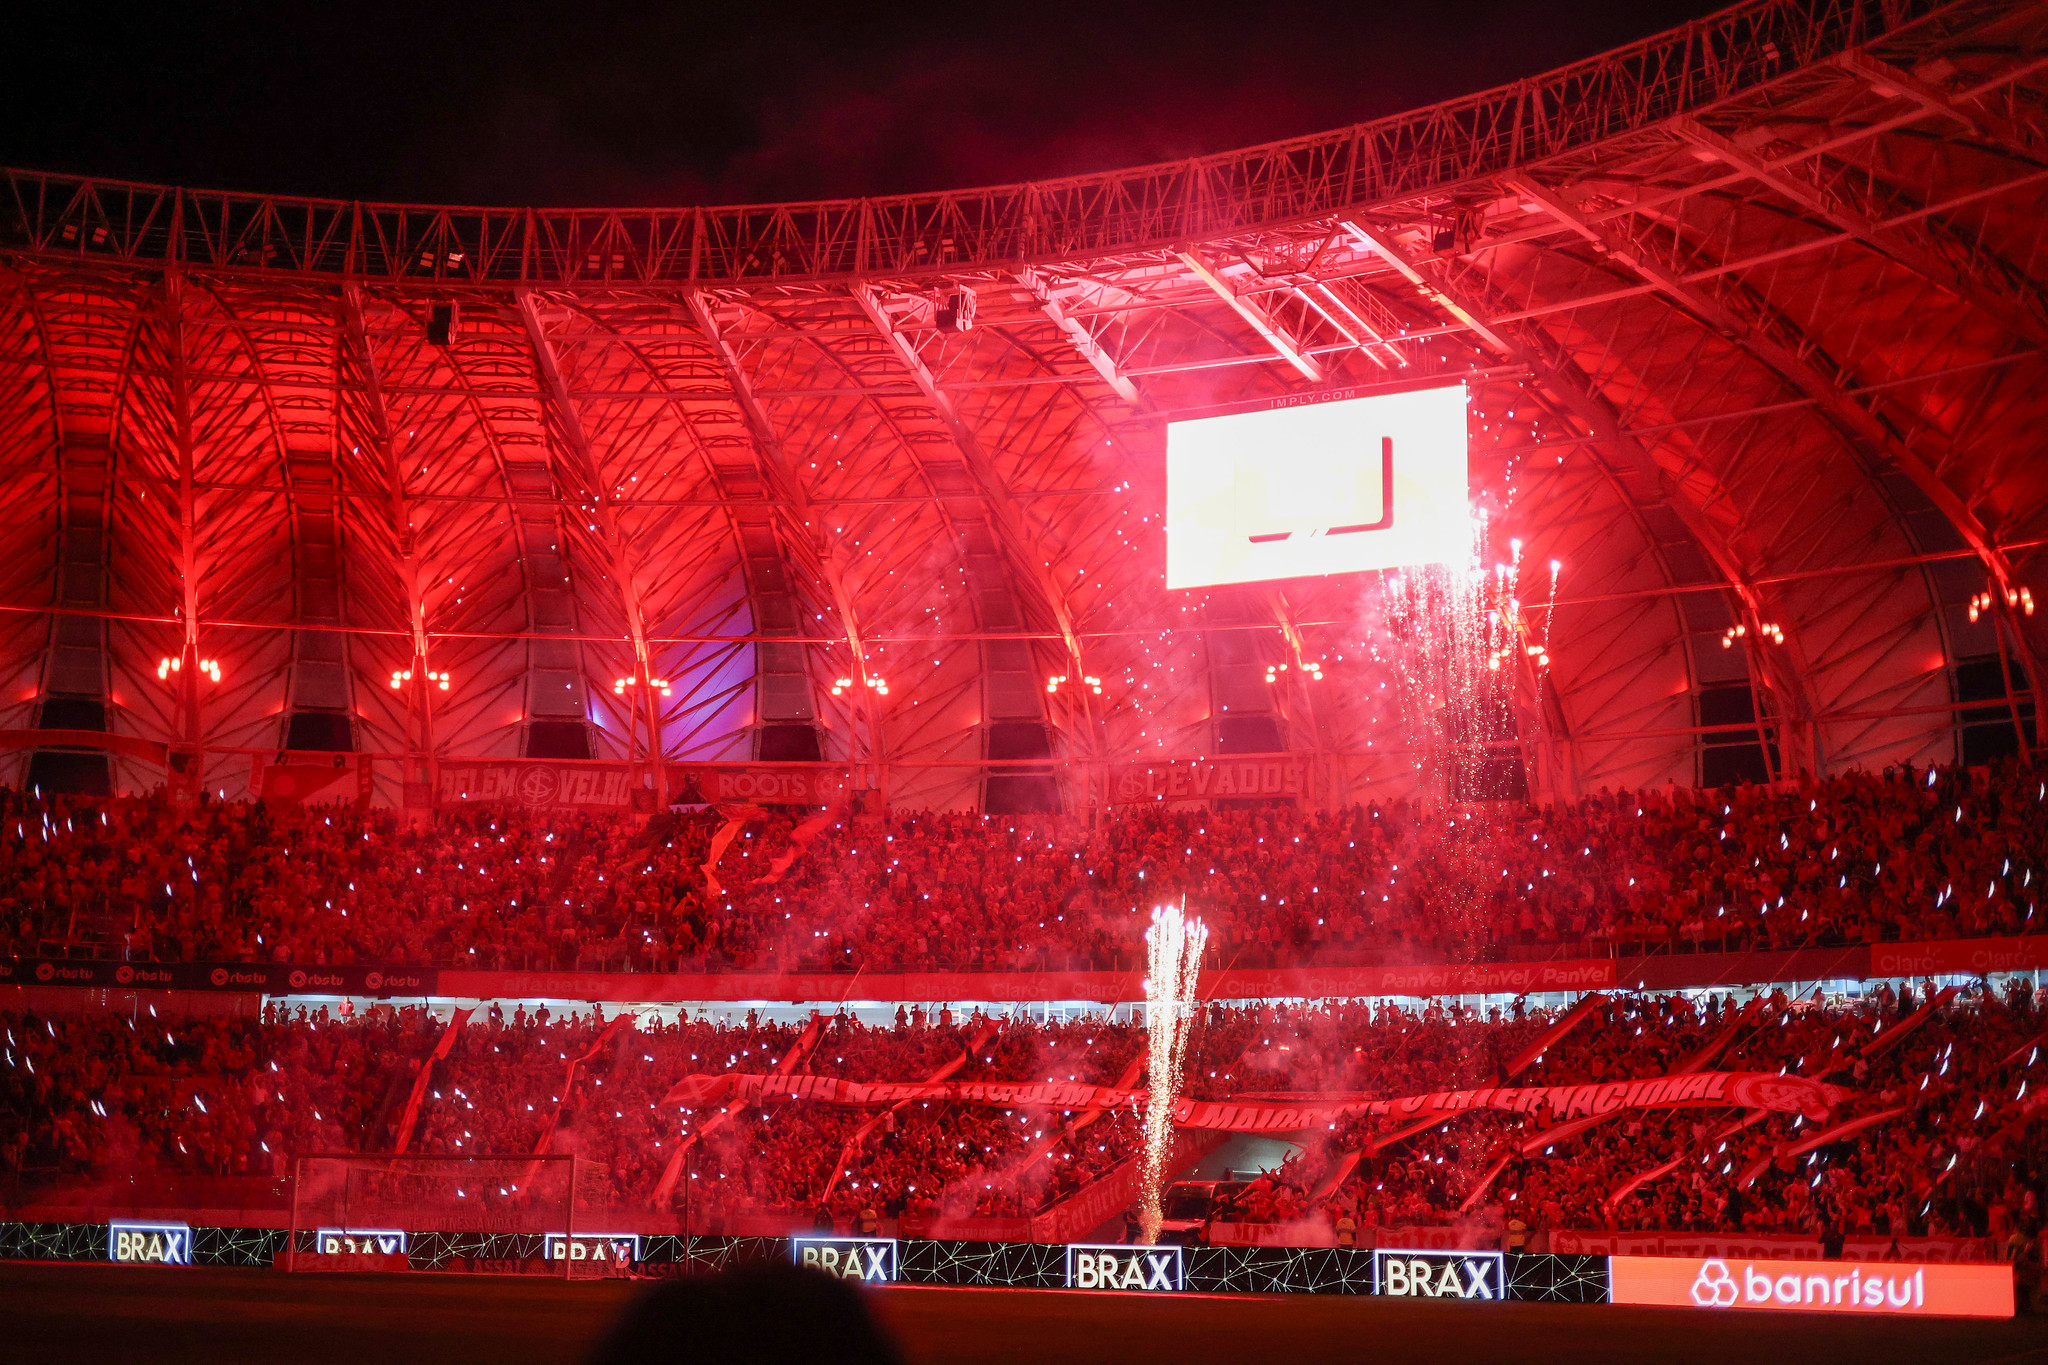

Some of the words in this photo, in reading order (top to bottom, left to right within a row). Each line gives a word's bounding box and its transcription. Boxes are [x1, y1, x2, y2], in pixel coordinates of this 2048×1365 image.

[1270, 389, 1356, 408] IMPLY.COM
[440, 763, 518, 803] BELÉM
[719, 773, 807, 797] ROOTS
[1880, 953, 1935, 973] Claro
[1971, 949, 2028, 968] Claro
[1381, 972, 1450, 989] PanVel
[1462, 969, 1530, 987] PanVel
[1542, 965, 1611, 984] PanVel
[1225, 979, 1276, 996] Claro
[116, 1230, 183, 1263] BRAX
[803, 1246, 888, 1281] BRAX
[1077, 1254, 1172, 1290] BRAX
[1386, 1259, 1493, 1299] BRAX
[1745, 1265, 1926, 1308] banrisul
